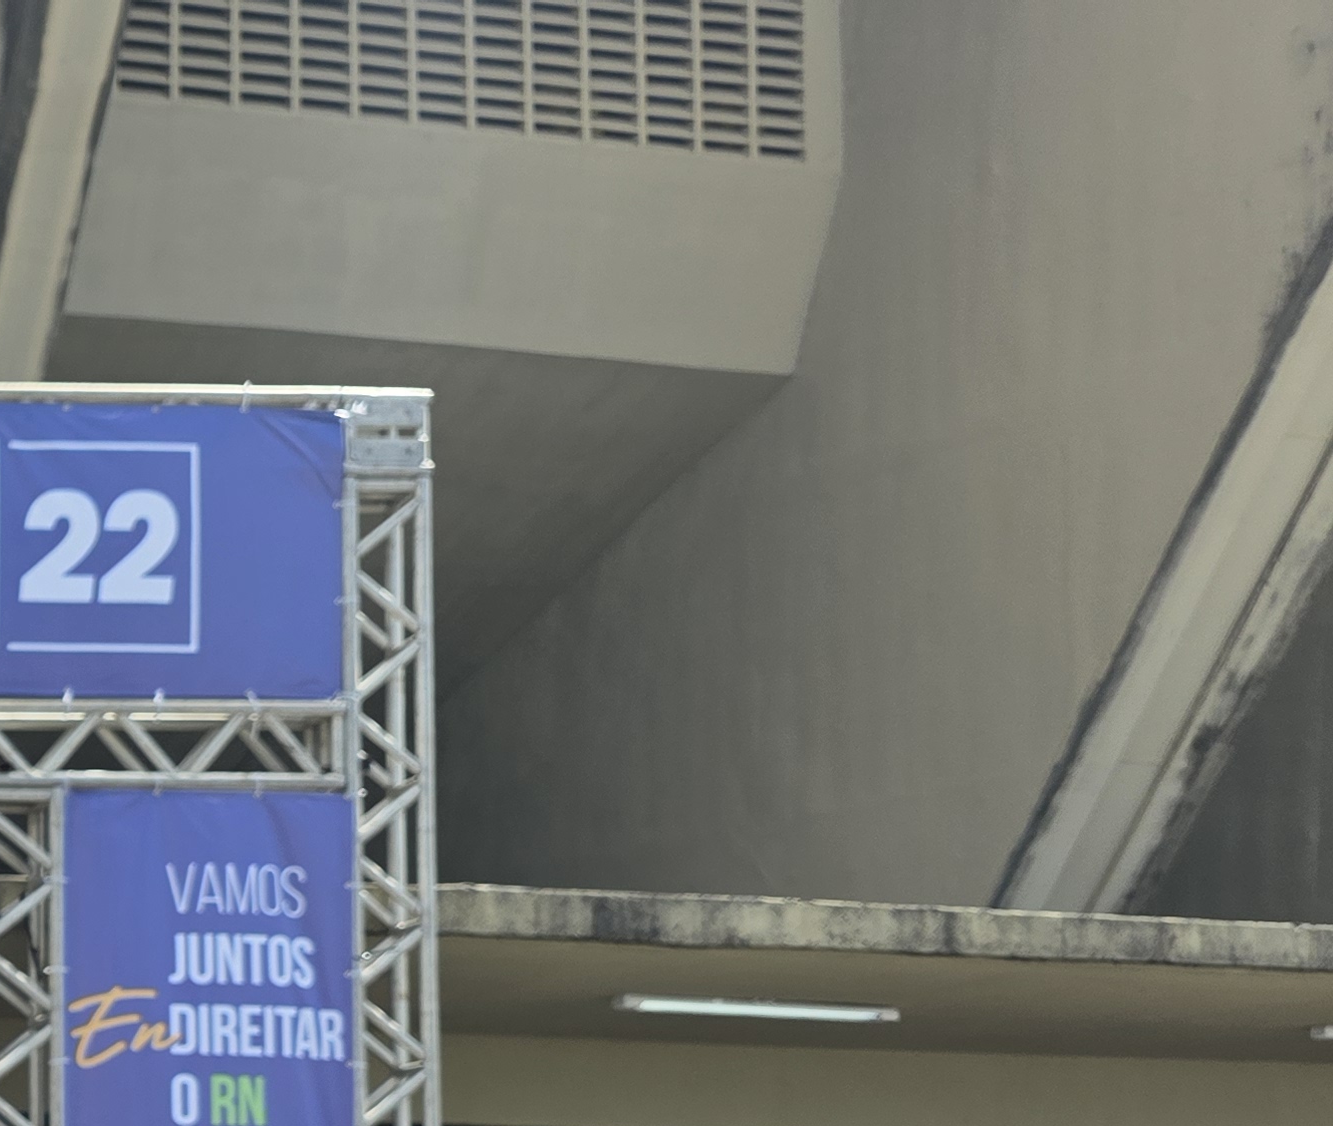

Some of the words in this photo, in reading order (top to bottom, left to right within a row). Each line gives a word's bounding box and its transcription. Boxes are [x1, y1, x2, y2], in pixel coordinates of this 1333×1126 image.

[18, 488, 179, 604] 22
[165, 861, 308, 919] VAMOS
[167, 932, 316, 989] JUNTOS
[171, 1072, 200, 1126] O
